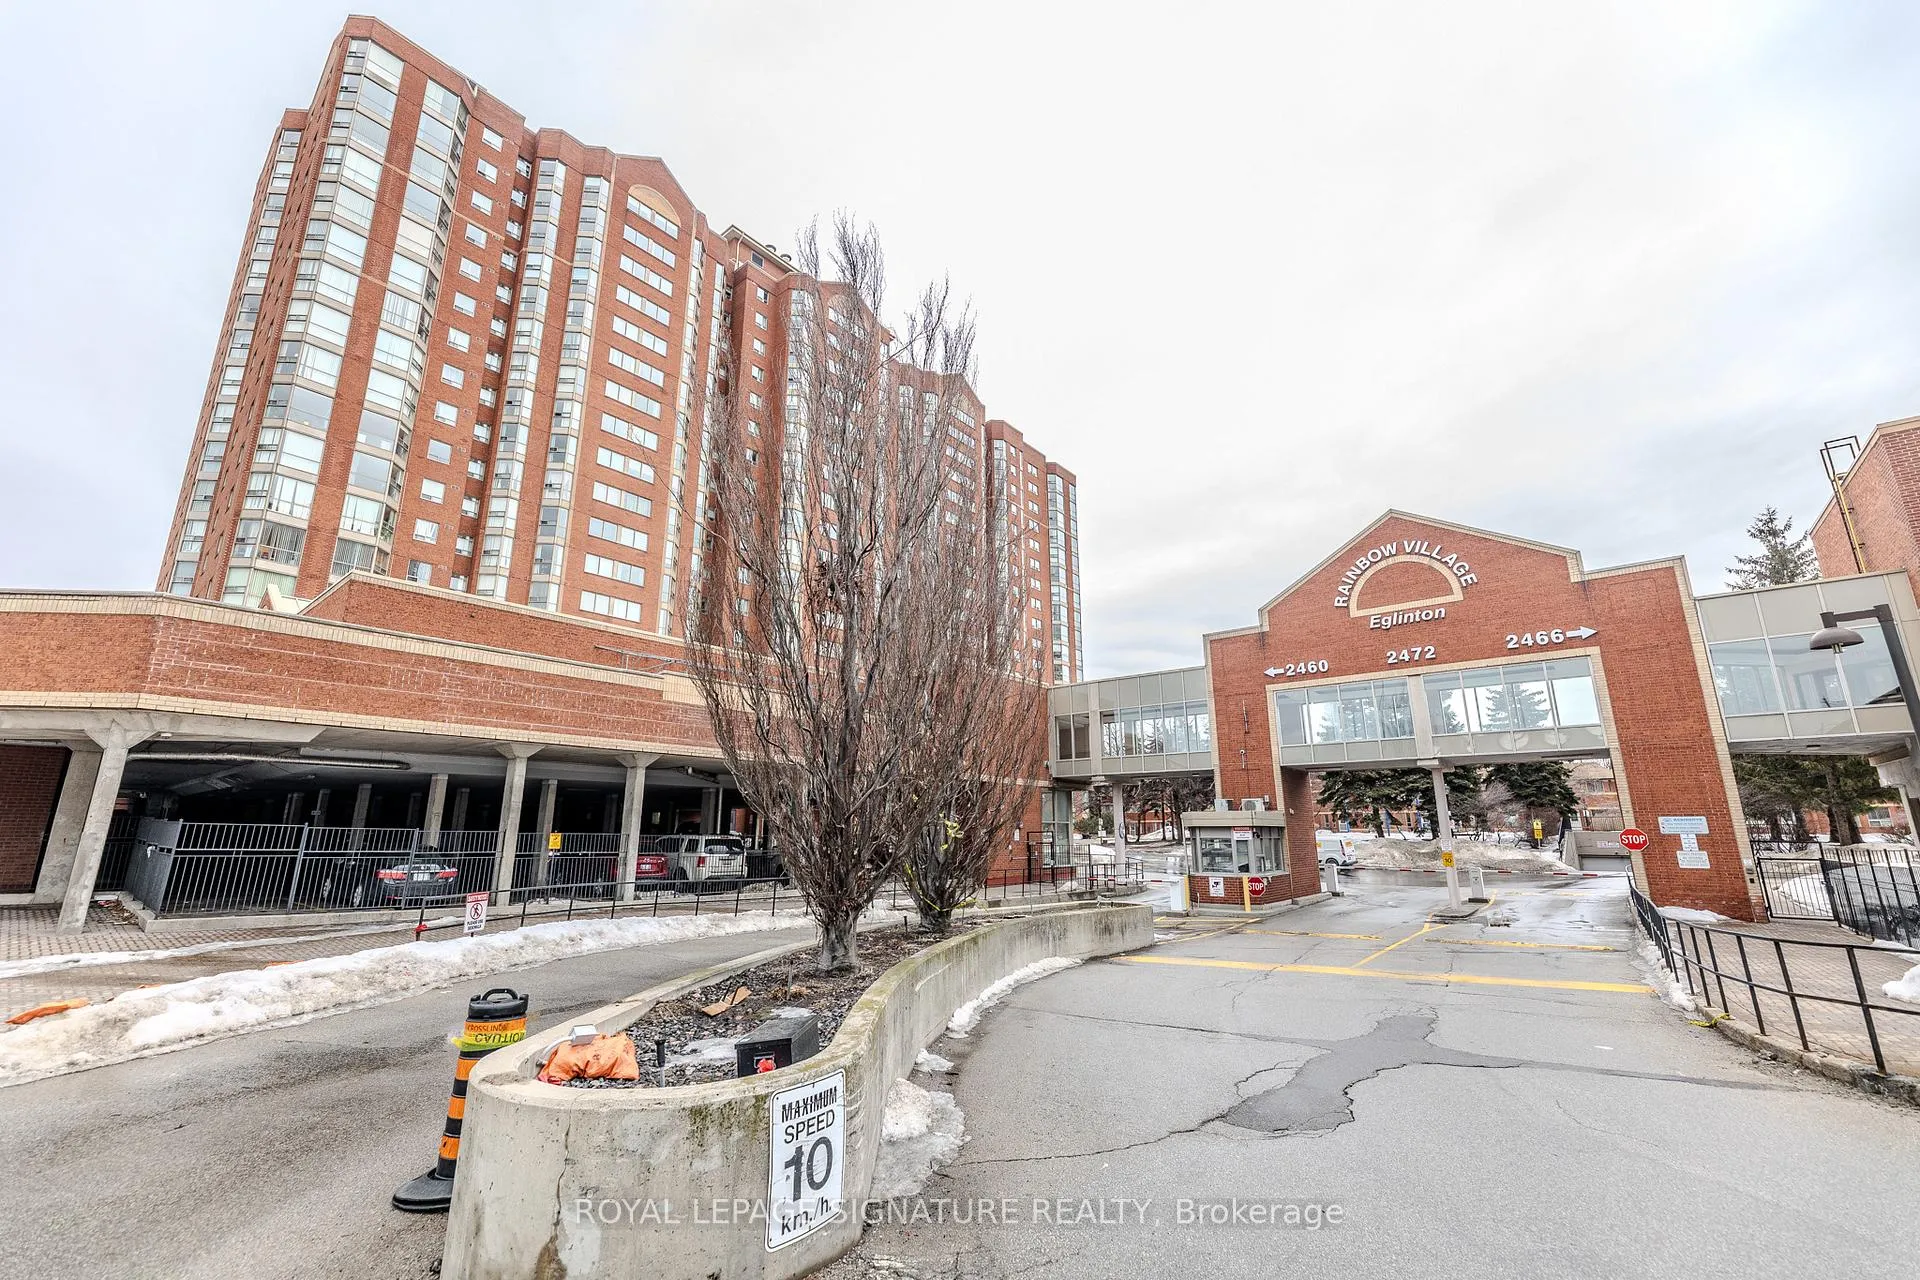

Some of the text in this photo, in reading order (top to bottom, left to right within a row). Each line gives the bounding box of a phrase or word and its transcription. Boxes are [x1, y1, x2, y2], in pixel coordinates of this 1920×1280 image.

[1334, 540, 1478, 608] RAINBOW VILLAGE
[1369, 608, 1446, 630] Eglinton
[1505, 628, 1565, 650] 2466
[1386, 645, 1436, 665] 2472
[1285, 659, 1329, 677] 2460
[1621, 834, 1646, 844] STOP
[1248, 882, 1264, 891] STOP
[781, 1086, 837, 1124] MAXIMUM
[784, 1109, 836, 1144] SPEED
[784, 1136, 833, 1203] 10
